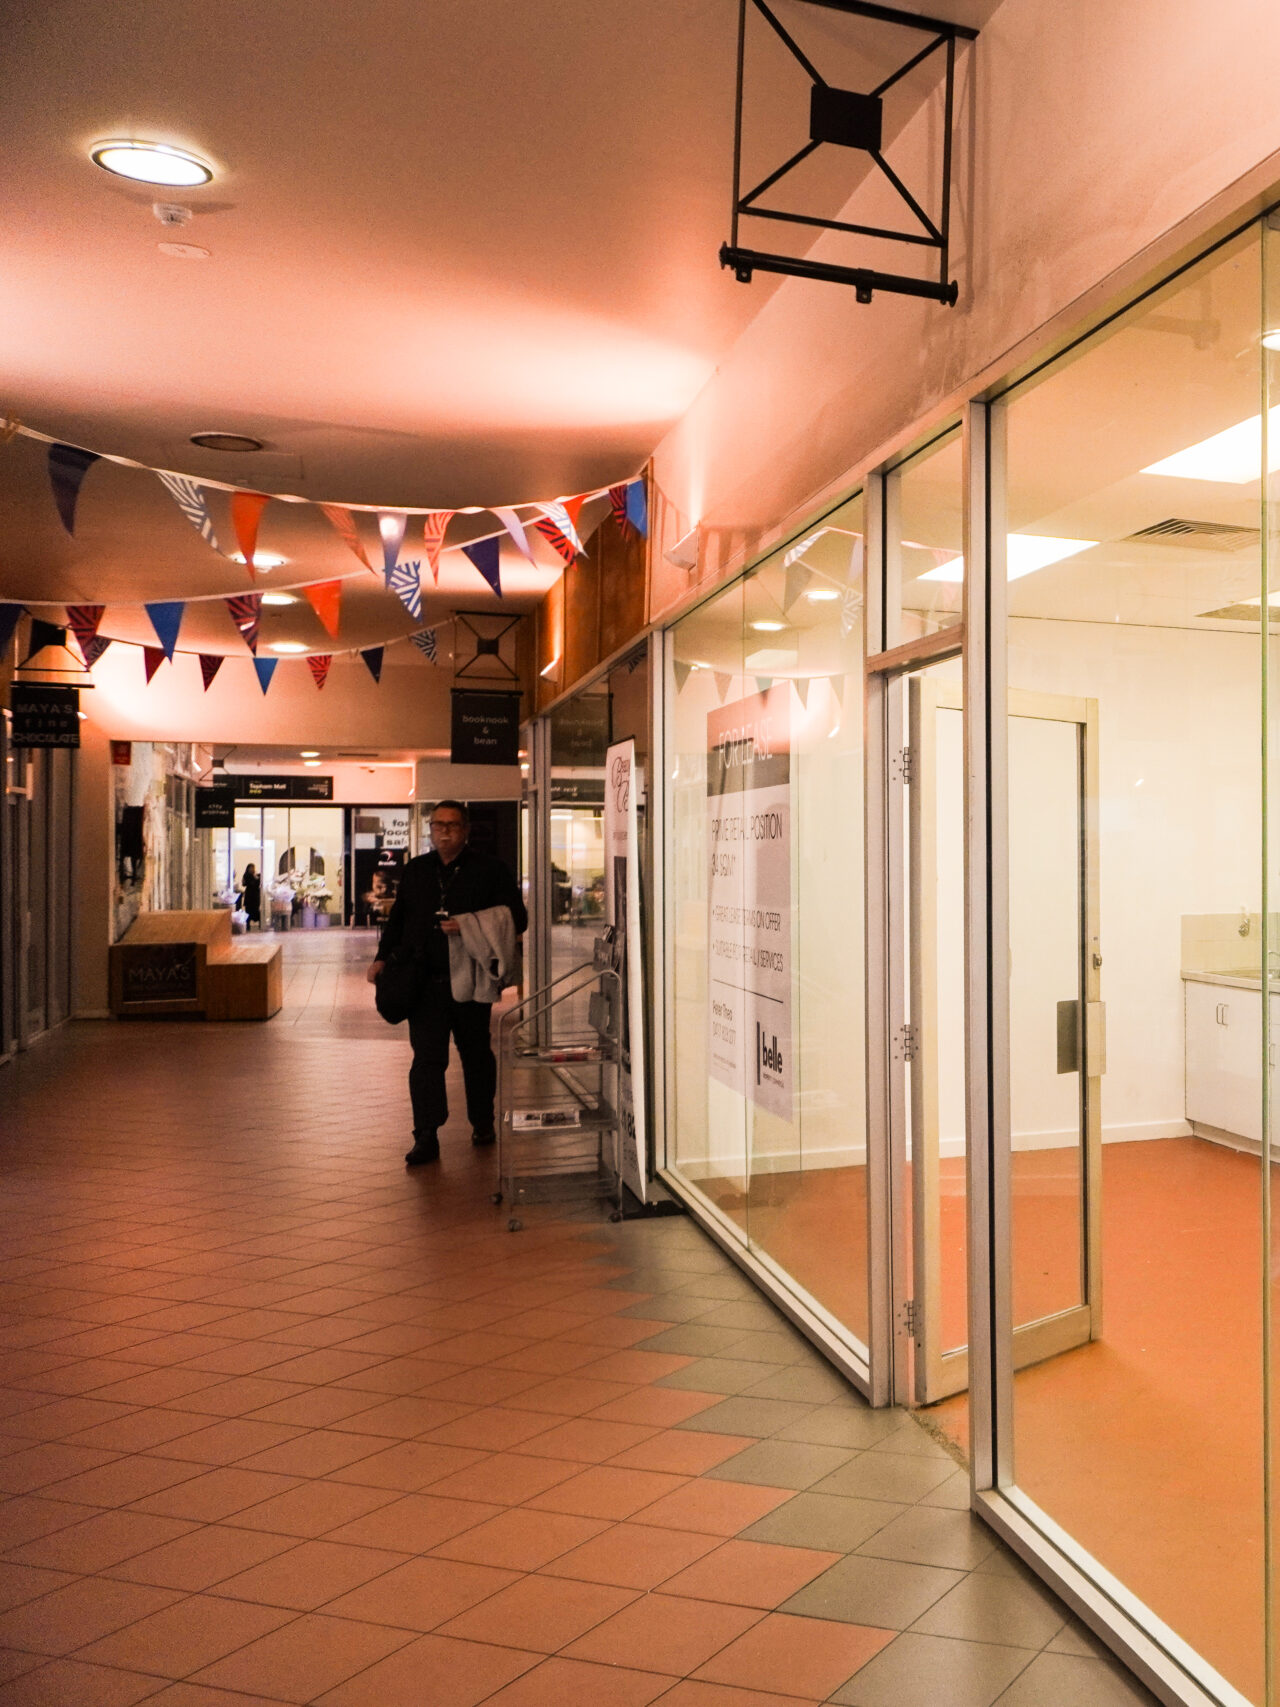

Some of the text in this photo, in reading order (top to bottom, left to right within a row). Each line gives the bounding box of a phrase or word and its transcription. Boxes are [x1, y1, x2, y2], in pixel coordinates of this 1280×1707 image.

[462, 714, 509, 724] booknook
[718, 716, 773, 770] FOR LEASE
[750, 812, 783, 841] POSITION
[765, 911, 781, 932] OFFER
[762, 1031, 783, 1074] belle
